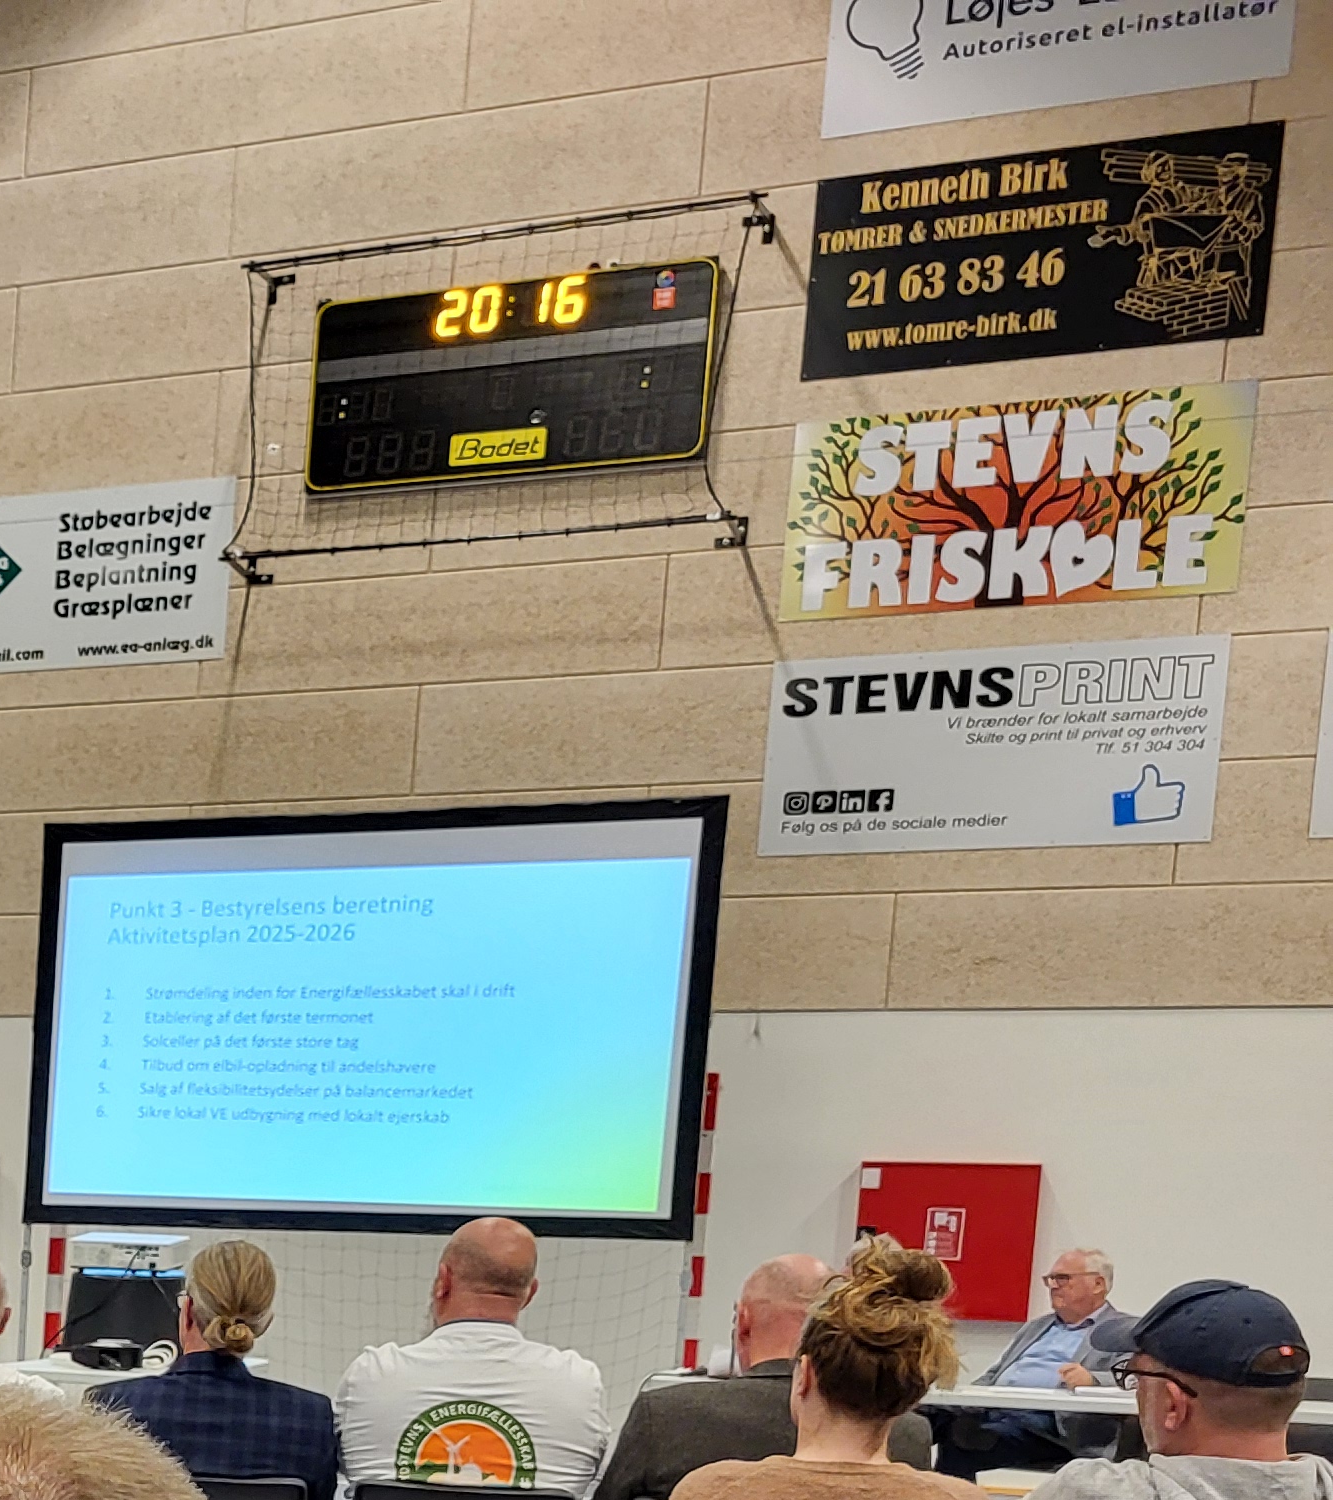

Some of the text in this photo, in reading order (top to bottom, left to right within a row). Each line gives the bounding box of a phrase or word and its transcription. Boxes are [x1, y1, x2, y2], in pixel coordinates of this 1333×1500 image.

[943, 0, 1279, 60] Autoriseret el-installatør
[860, 158, 1068, 214] Kenneth Birk
[818, 198, 1109, 255] TØMRER & SNEDKERMESTER
[846, 248, 1065, 308] 21 63 83 46
[846, 307, 1058, 351] www.tomre-birk.dk
[455, 436, 541, 461] Bodet
[855, 399, 1173, 497] STEVNS
[56, 532, 206, 561] Belægninger
[55, 561, 197, 592] Beplantning
[53, 593, 193, 620] Græsplæner
[77, 634, 214, 657] www.ea-anlæg.dk
[947, 705, 1208, 729] Vi brænder for lokalt samarbejde
[965, 723, 1207, 745] Skilte og print til privat og erhverv
[1121, 741, 1139, 753] 51
[1144, 740, 1172, 752] 304
[1176, 738, 1205, 750] 304
[781, 813, 1008, 836] Følg os på de sociale medier
[109, 901, 164, 919] Punkt
[170, 901, 182, 919] 3
[201, 899, 325, 921] Bestyrelsens
[332, 894, 435, 917] beretning
[107, 923, 356, 948] Aktivitetsplan 2025-2026
[104, 987, 115, 1000] 1.
[146, 985, 229, 1003] Strømdeling
[234, 985, 272, 1000] inden
[276, 985, 296, 1000] for
[300, 984, 436, 1002] Energifællesskabet
[441, 984, 470, 999] skal
[482, 984, 516, 998] drift
[102, 1009, 374, 1026] 2. Etablering af det første termonet
[100, 1034, 359, 1051] 3. Solceller på det første store tag
[98, 1058, 436, 1076] 4. Tilbud om elbil-opladning til andelshavere
[97, 1082, 474, 1099] 5. Salg af fleksibilitetsydelser på balancemarkedet
[95, 1105, 450, 1126] 6. Sikre lokal VE udbygning med lokalt ejerskab
[430, 1404, 534, 1470] ENERGIFÆLLESSKAB
